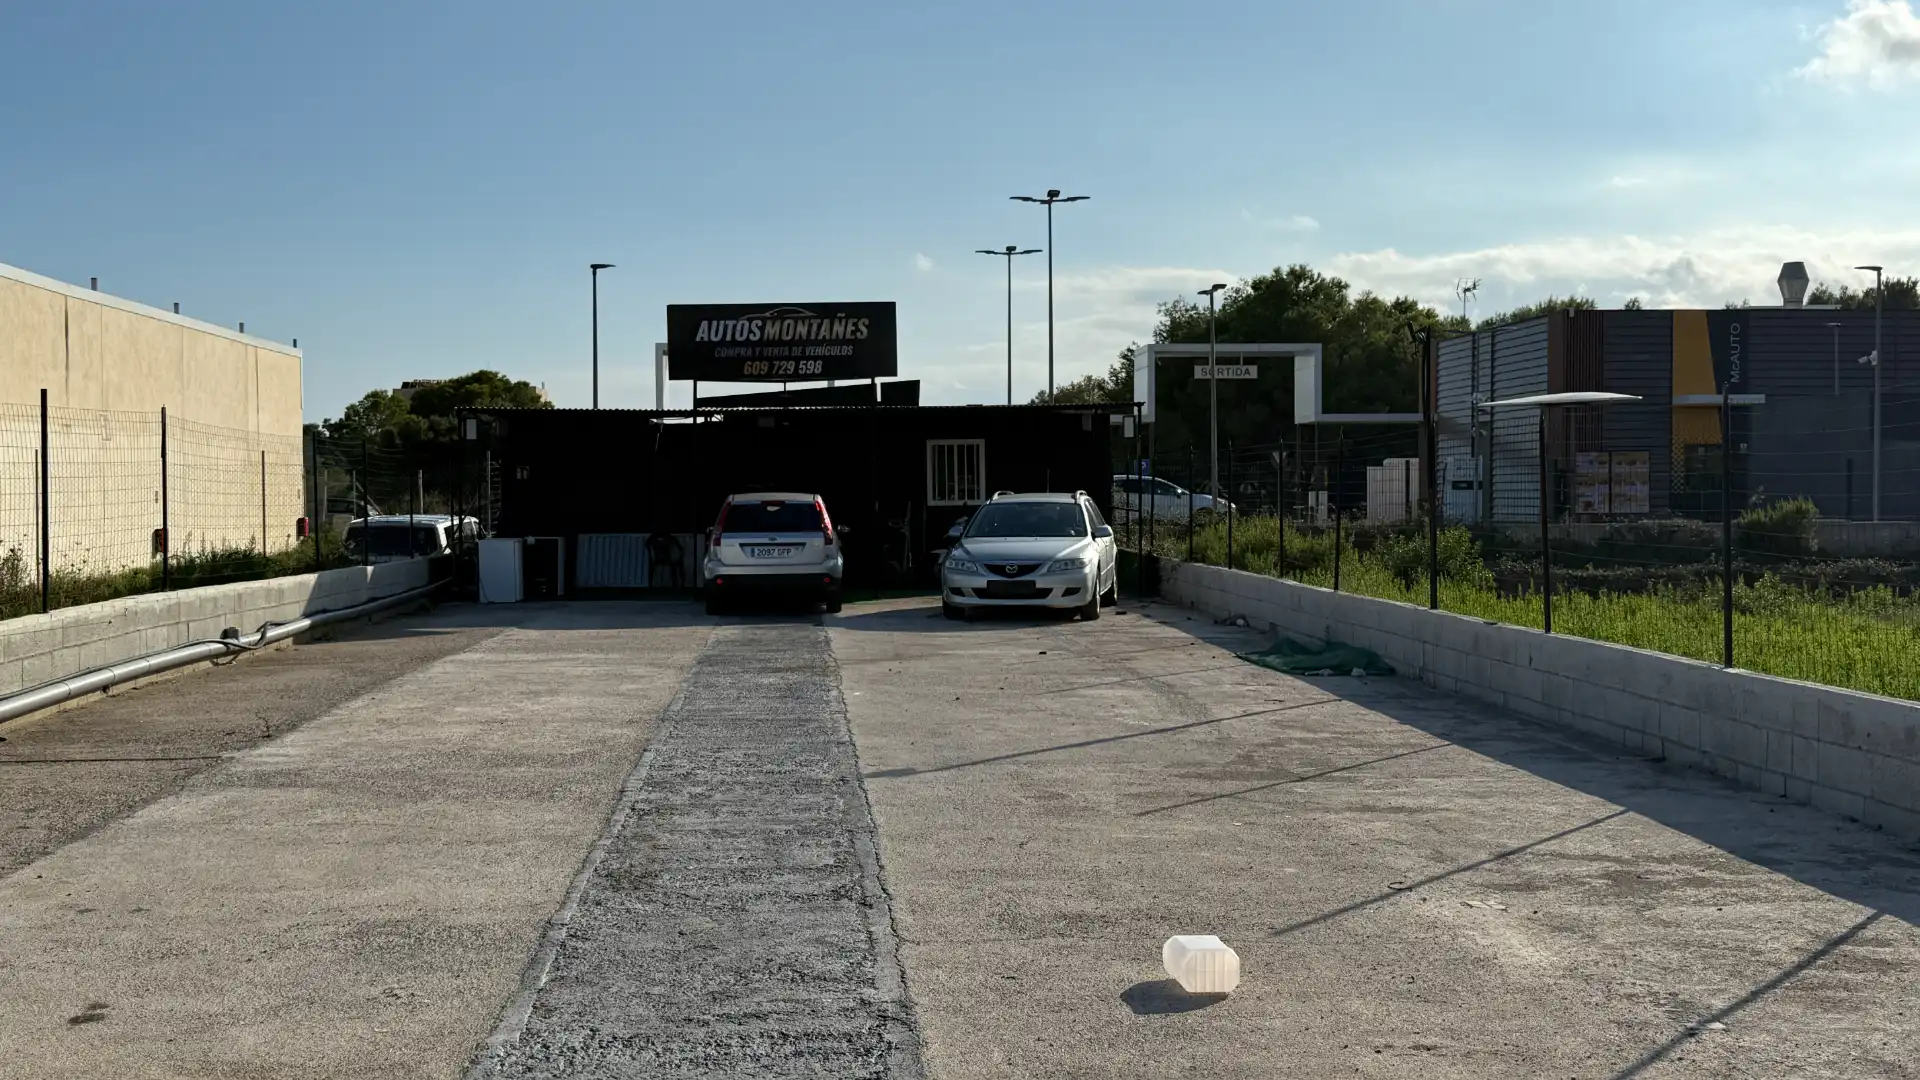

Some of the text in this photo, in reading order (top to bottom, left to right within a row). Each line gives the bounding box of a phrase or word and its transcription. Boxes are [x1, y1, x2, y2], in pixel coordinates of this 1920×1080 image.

[715, 344, 853, 358] COMPRA Y VENTA DE VEHÍCULOS
[1730, 323, 1740, 382] McAUTO
[743, 360, 822, 375] 609 729 598
[757, 548, 775, 557] 2097
